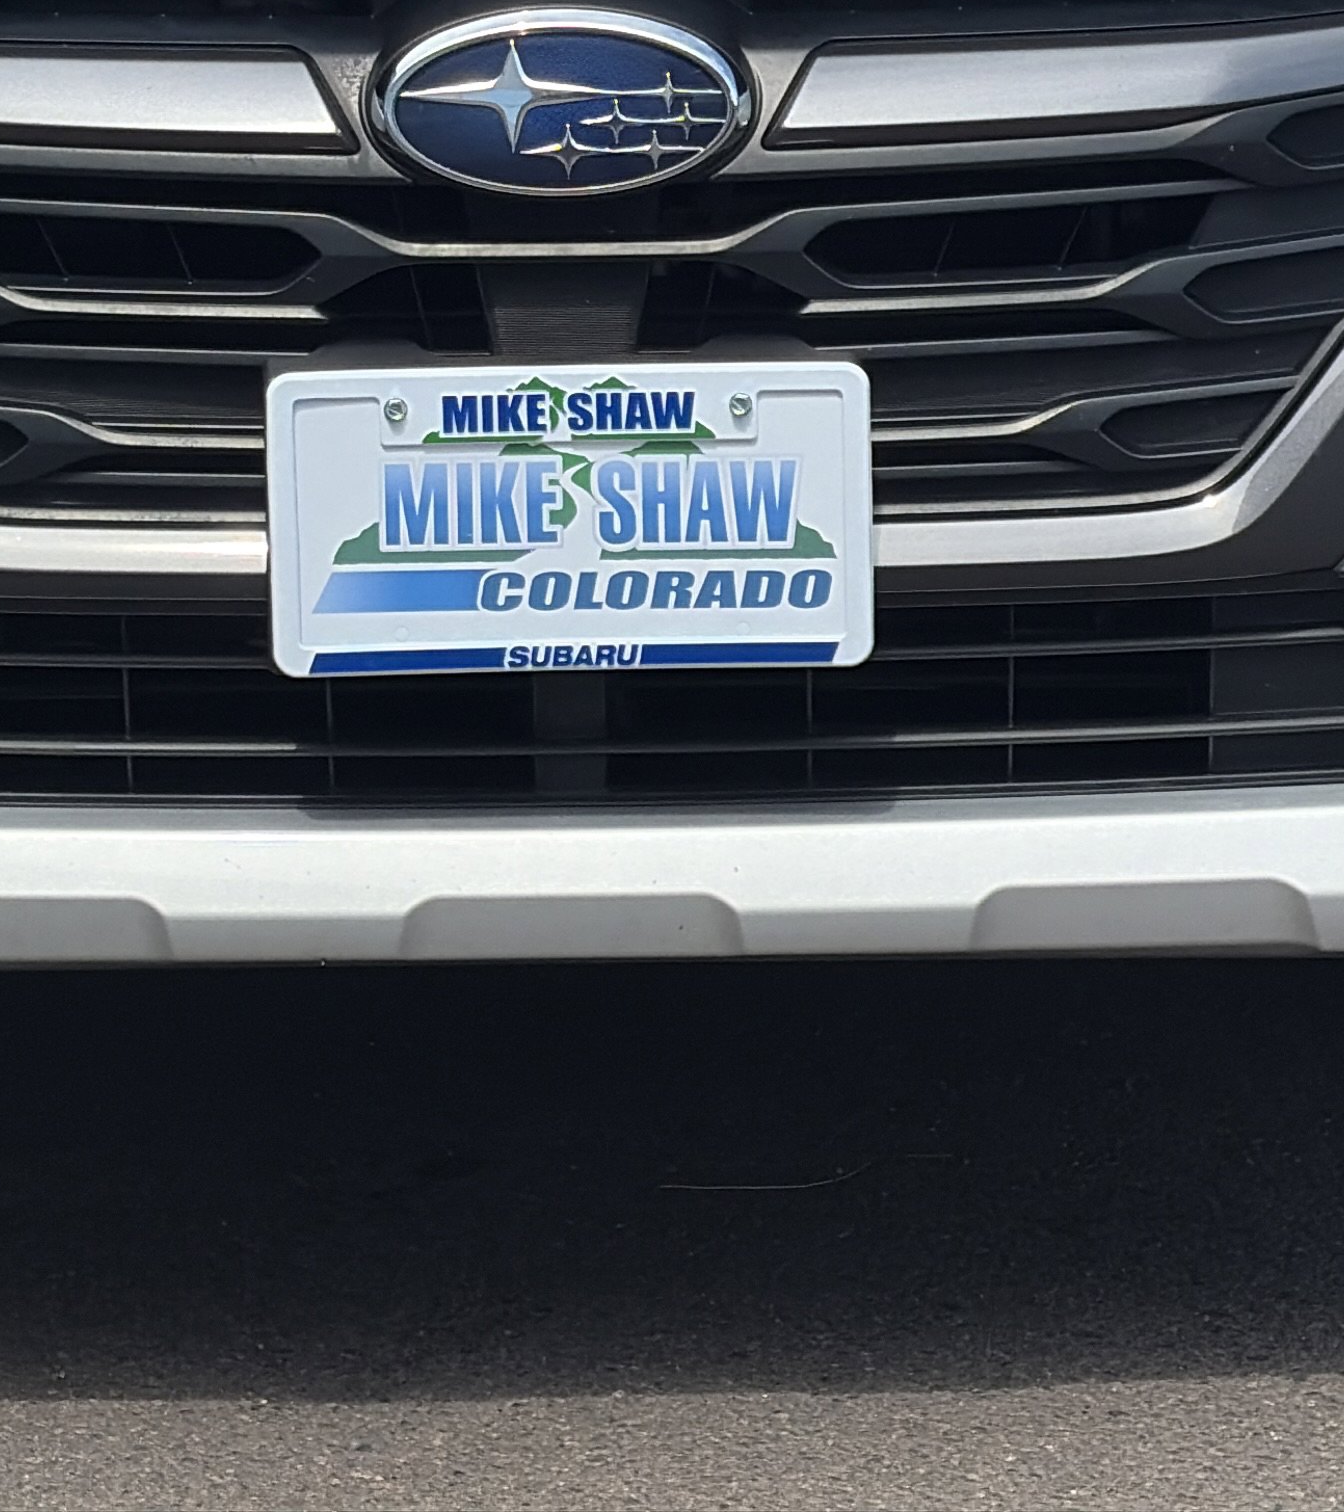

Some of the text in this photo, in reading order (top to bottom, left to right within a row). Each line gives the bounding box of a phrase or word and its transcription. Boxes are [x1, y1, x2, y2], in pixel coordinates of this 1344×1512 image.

[441, 391, 696, 434] MIKE SHAW
[383, 459, 798, 546] MIKE SHAW
[479, 568, 834, 612] COLORADO
[507, 643, 641, 668] SUBARU
